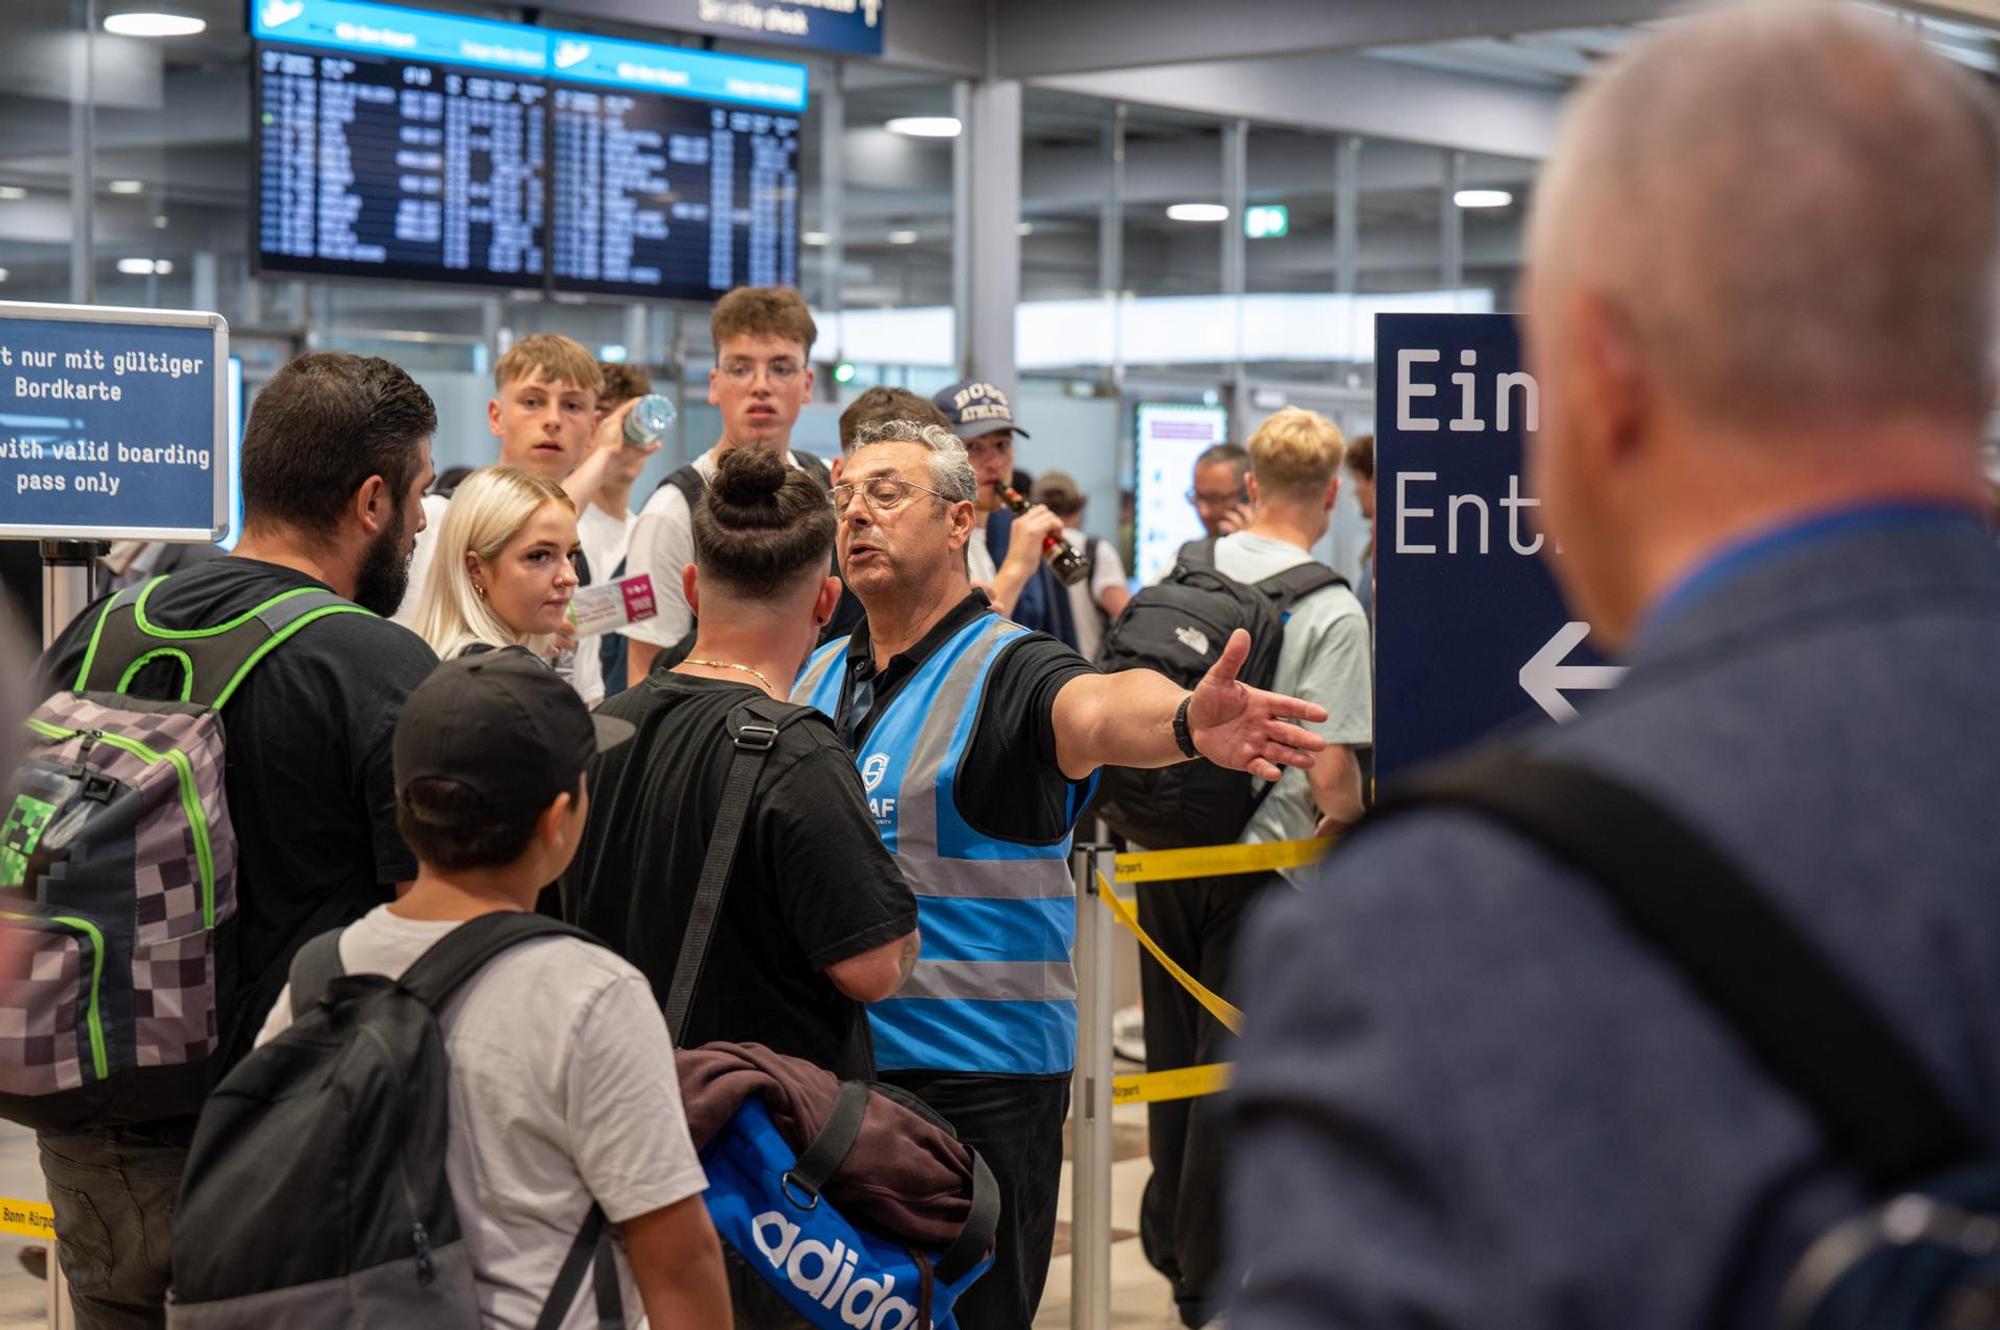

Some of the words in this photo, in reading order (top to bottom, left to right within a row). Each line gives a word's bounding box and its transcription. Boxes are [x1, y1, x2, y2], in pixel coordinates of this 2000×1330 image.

[22, 349, 57, 367] nur
[65, 349, 105, 370] mit
[113, 352, 203, 377] gültiger
[15, 377, 122, 401] Bordkarte
[1396, 349, 1540, 432] Ein
[52, 441, 109, 461] valid
[118, 443, 210, 470] boarding
[17, 473, 66, 494] pass
[75, 472, 121, 496] only
[1395, 471, 1563, 556] Ent
